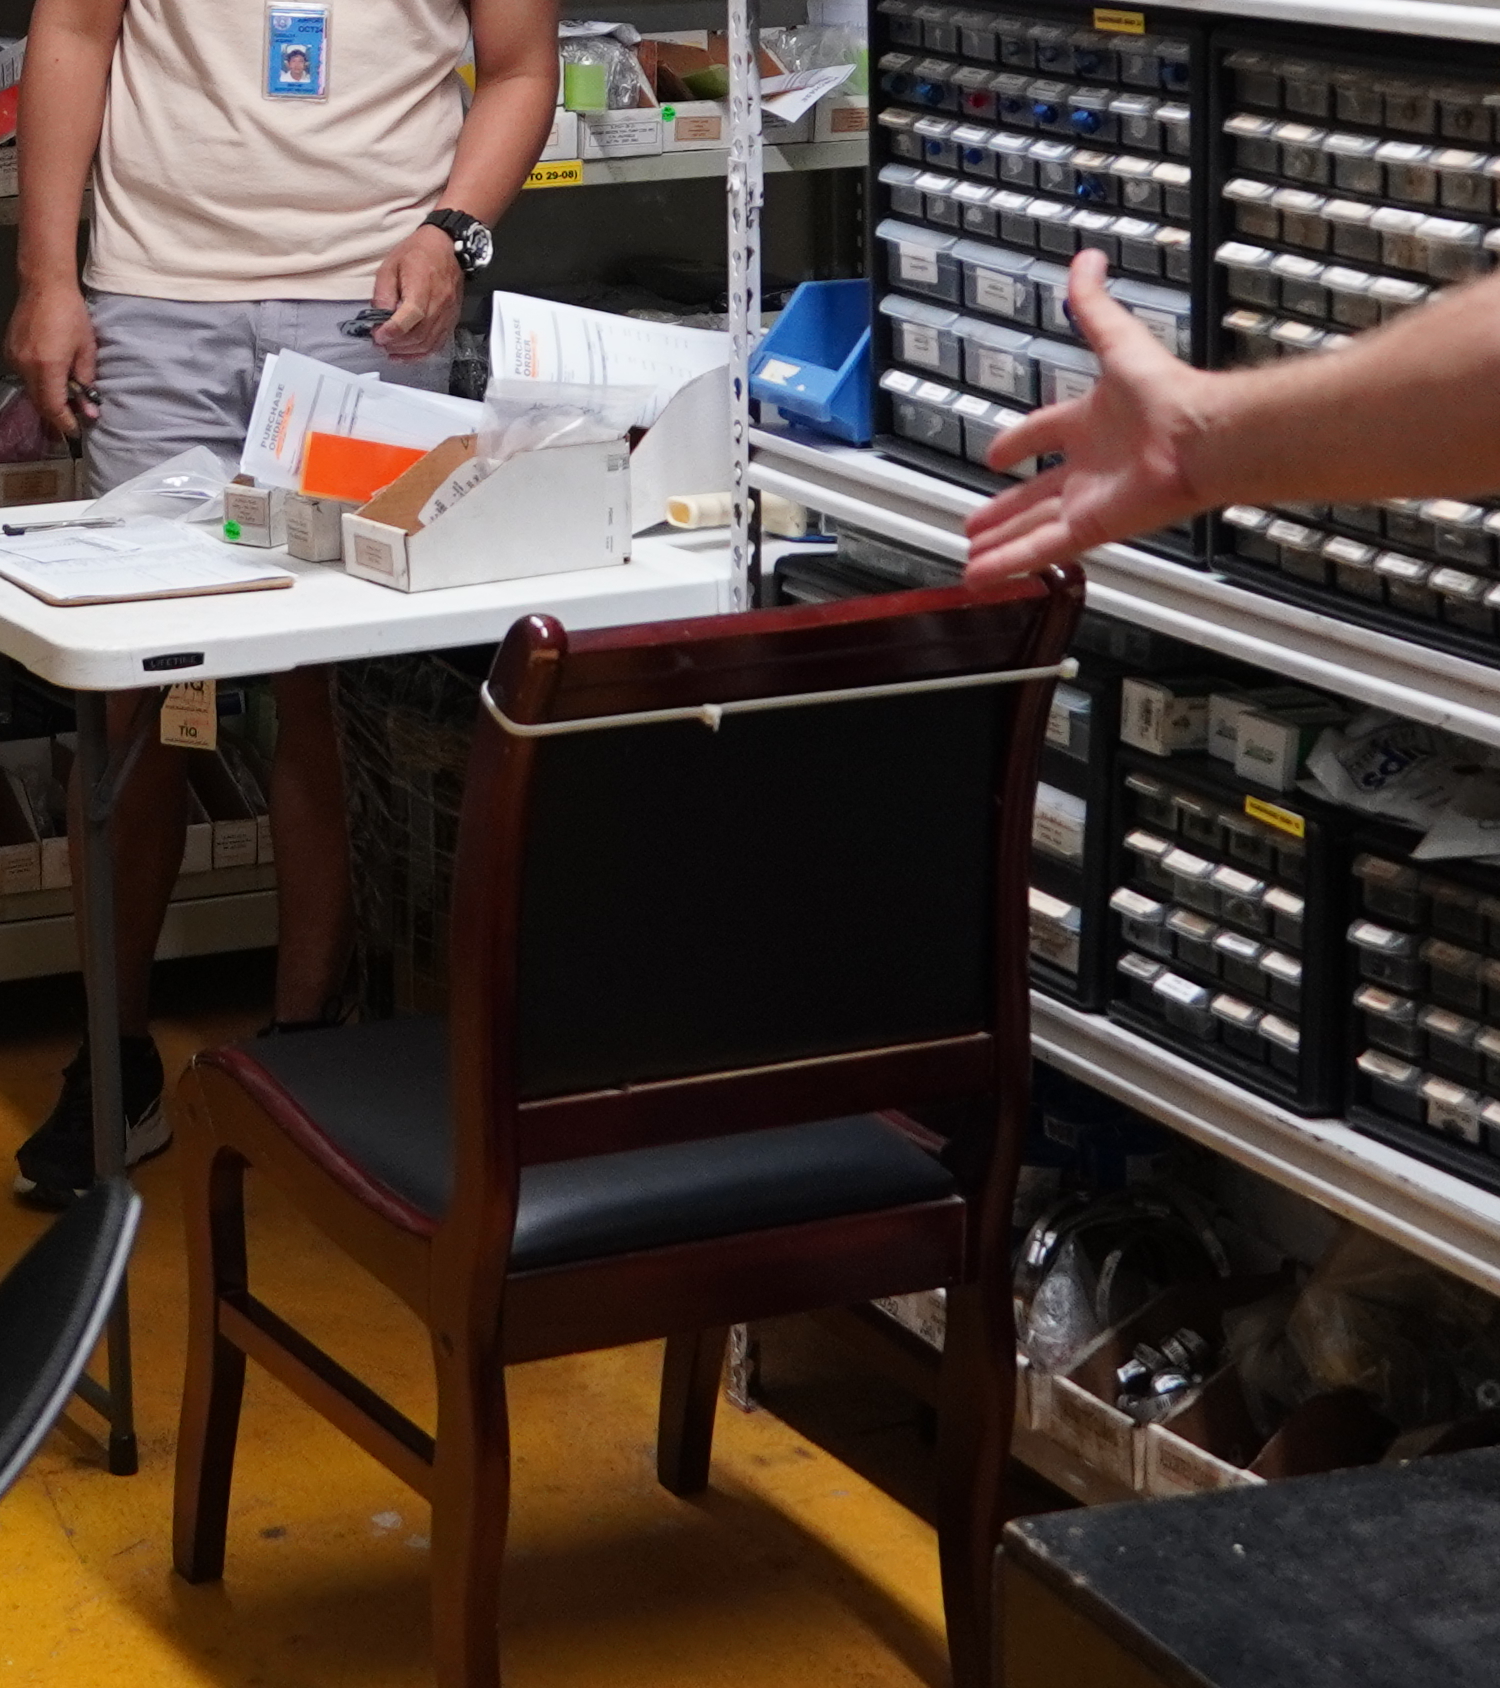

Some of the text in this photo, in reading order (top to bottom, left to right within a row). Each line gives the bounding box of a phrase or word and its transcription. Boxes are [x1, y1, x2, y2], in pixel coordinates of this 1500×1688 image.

[546, 169, 578, 181] 29-08)
[512, 317, 524, 376] PURCHASE
[523, 339, 532, 378] ORDER
[260, 383, 286, 450] PURCHASE
[268, 408, 286, 452] ORDER
[178, 725, 198, 738] TIQ
